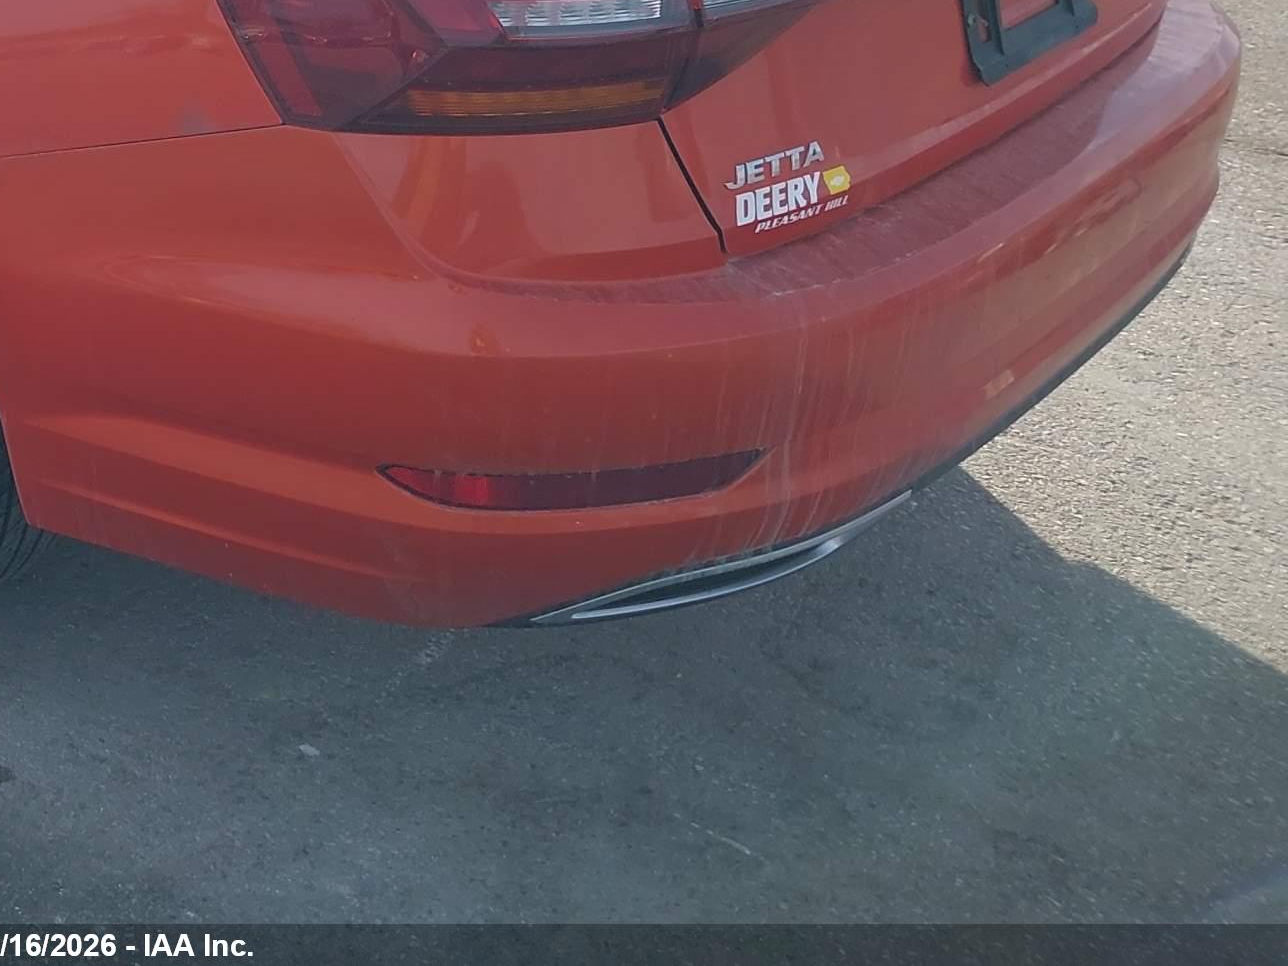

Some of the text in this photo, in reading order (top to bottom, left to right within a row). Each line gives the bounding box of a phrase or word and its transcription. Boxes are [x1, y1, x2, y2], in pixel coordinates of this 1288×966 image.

[724, 141, 824, 189] JETTA
[735, 171, 821, 227] DEERY
[754, 195, 849, 233] PLEASANT HILL
